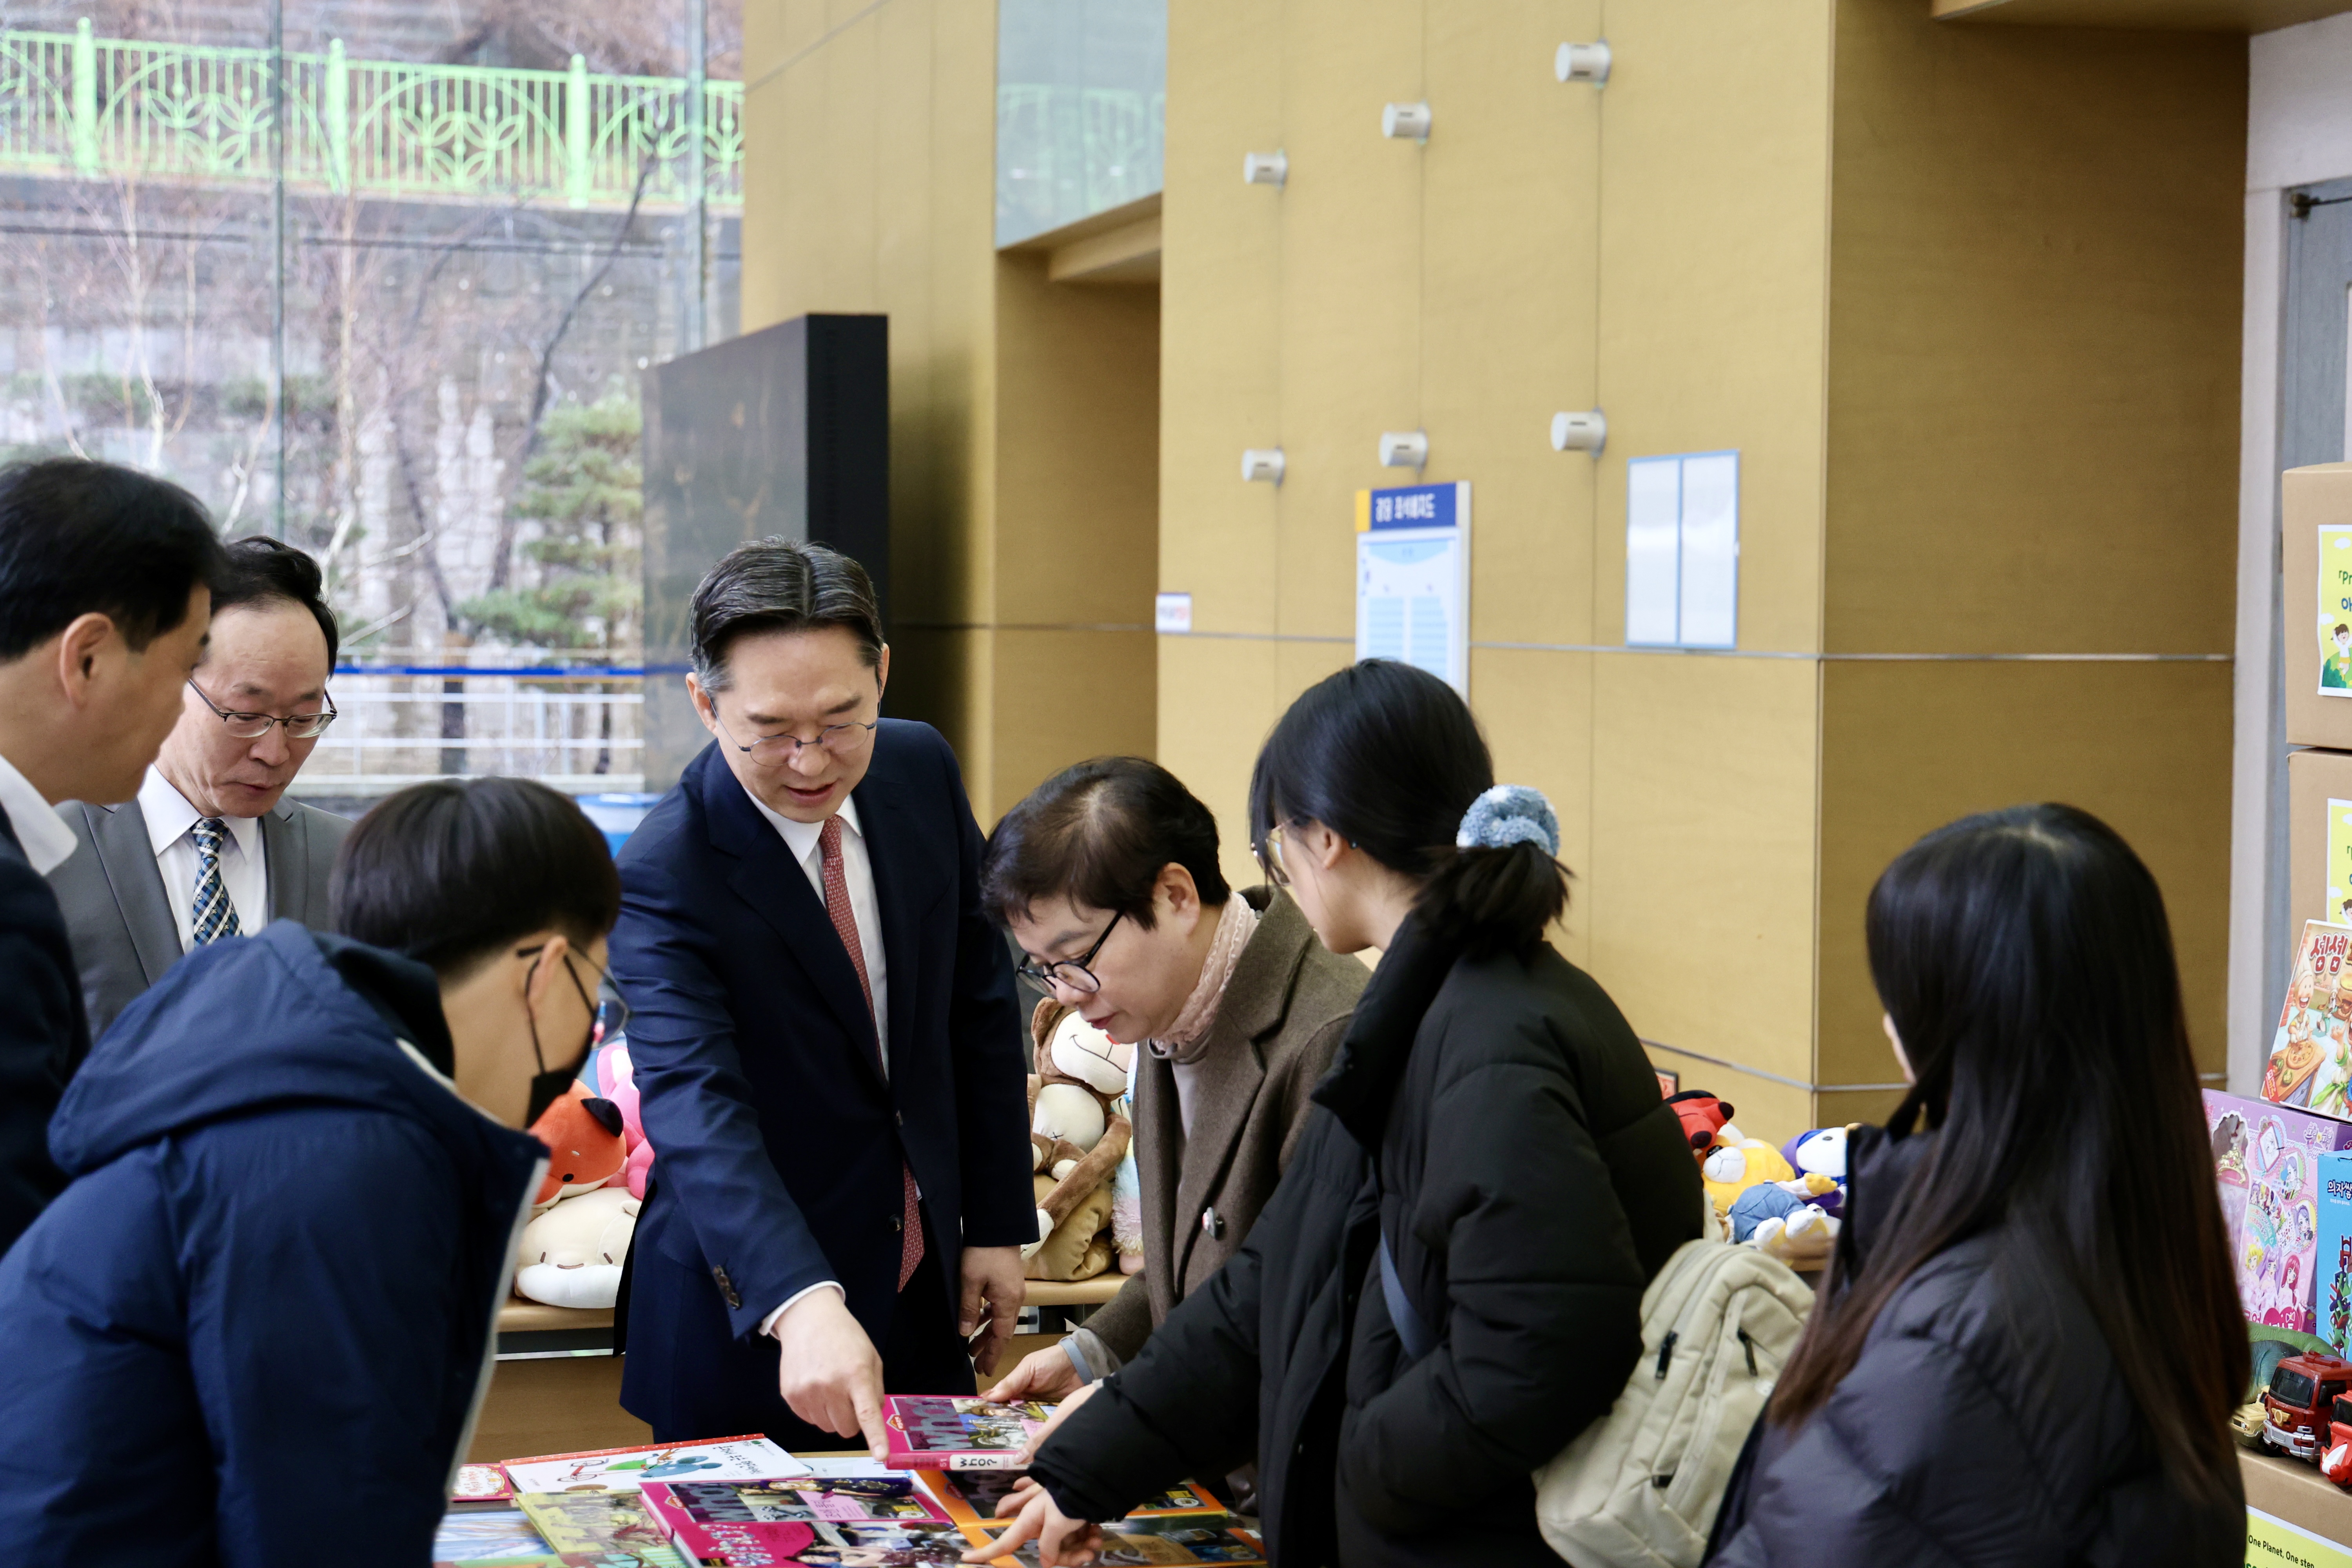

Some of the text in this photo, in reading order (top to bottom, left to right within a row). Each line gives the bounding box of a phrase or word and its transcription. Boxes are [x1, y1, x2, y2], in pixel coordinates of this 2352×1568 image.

[960, 1457, 997, 1467] who?
[2249, 1535, 2261, 1547] One
[2263, 1541, 2284, 1559] Planet,
[2286, 1551, 2298, 1564] One
